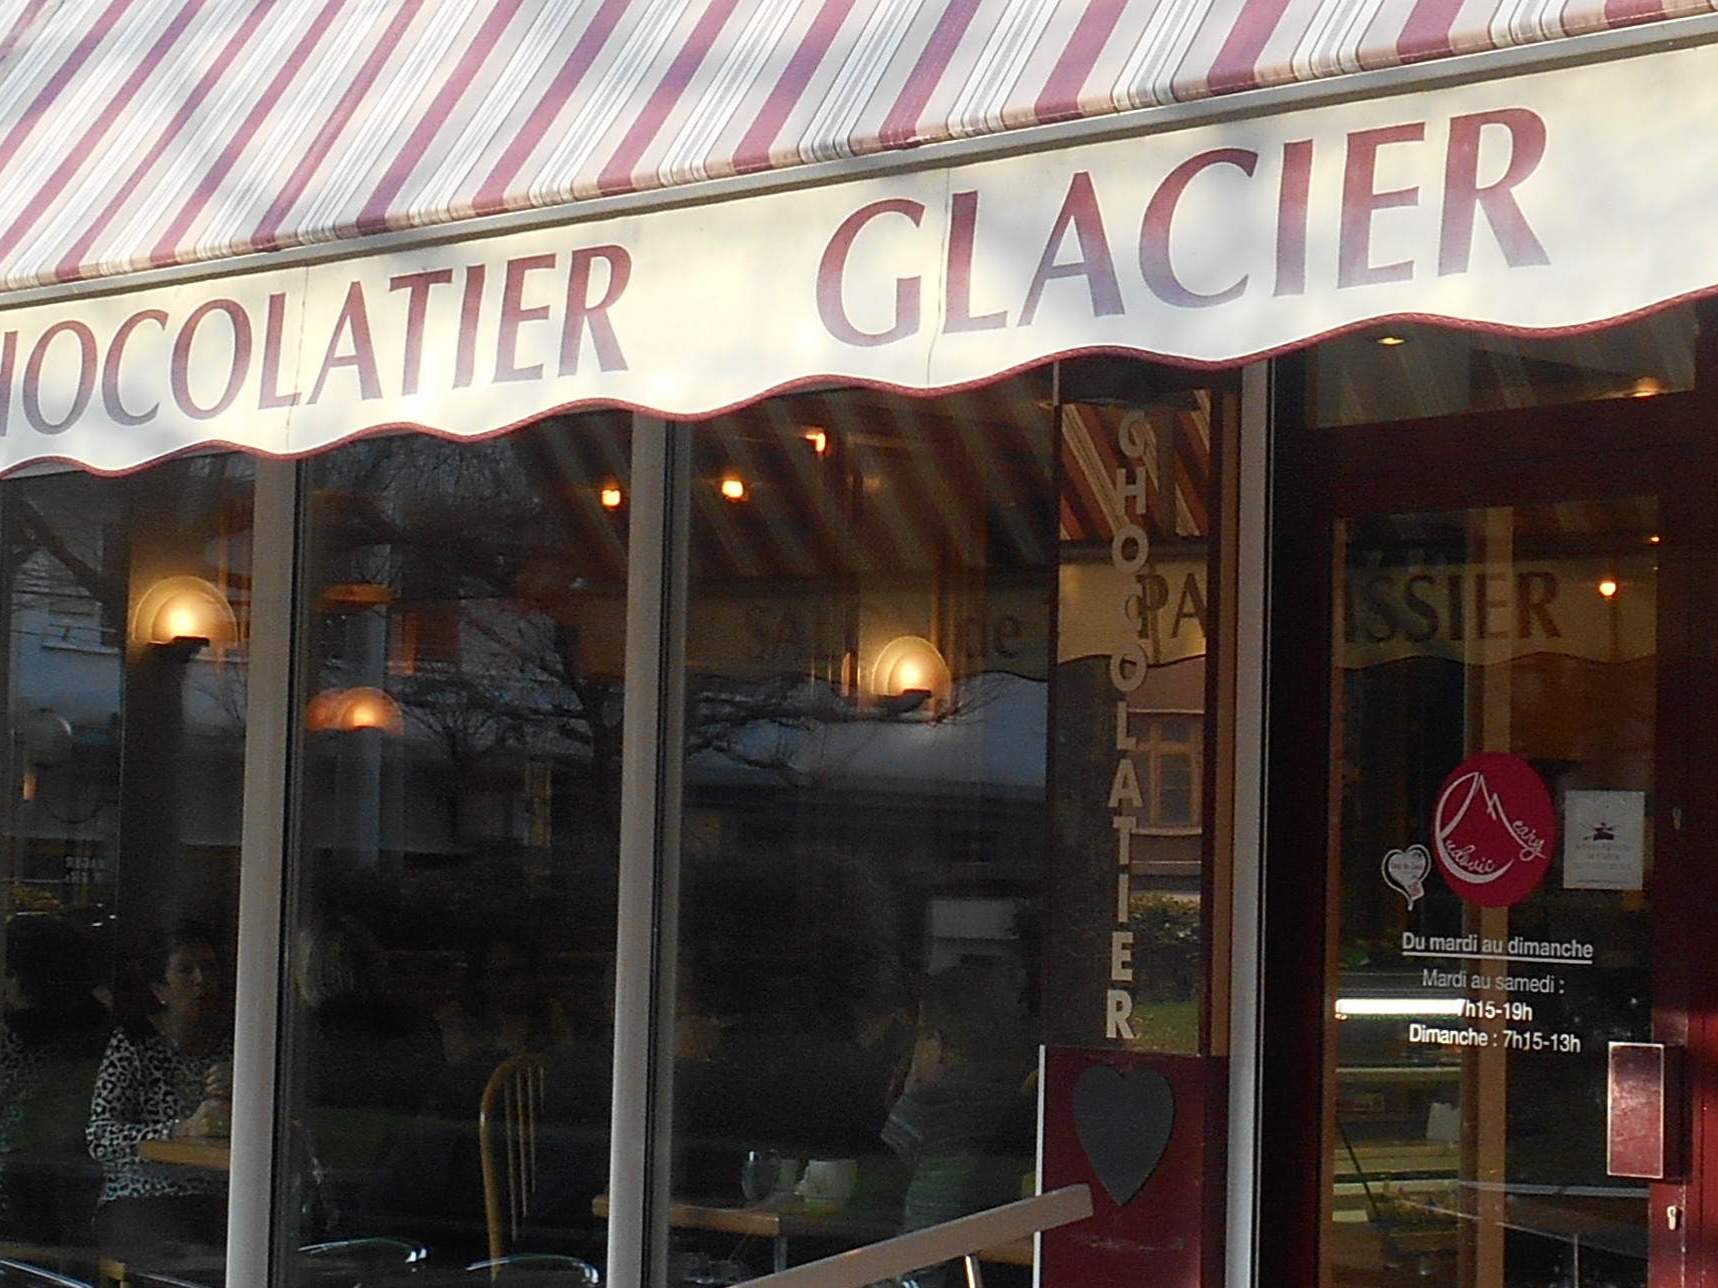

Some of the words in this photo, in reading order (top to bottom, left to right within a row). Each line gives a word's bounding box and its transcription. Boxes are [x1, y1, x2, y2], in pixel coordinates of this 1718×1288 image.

[814, 106, 1553, 348] GLACIER
[1402, 931, 1427, 952] Du
[1429, 934, 1477, 954] mardi
[1482, 939, 1503, 955] au
[1507, 937, 1594, 959] dimanche
[1422, 969, 1467, 989] Mardi
[1470, 973, 1492, 990] au
[1496, 972, 1555, 994] samedi
[1457, 999, 1533, 1022] 7h15-19h
[1409, 1024, 1488, 1048] Dimanche
[1502, 1030, 1581, 1054] 7h15-13h
